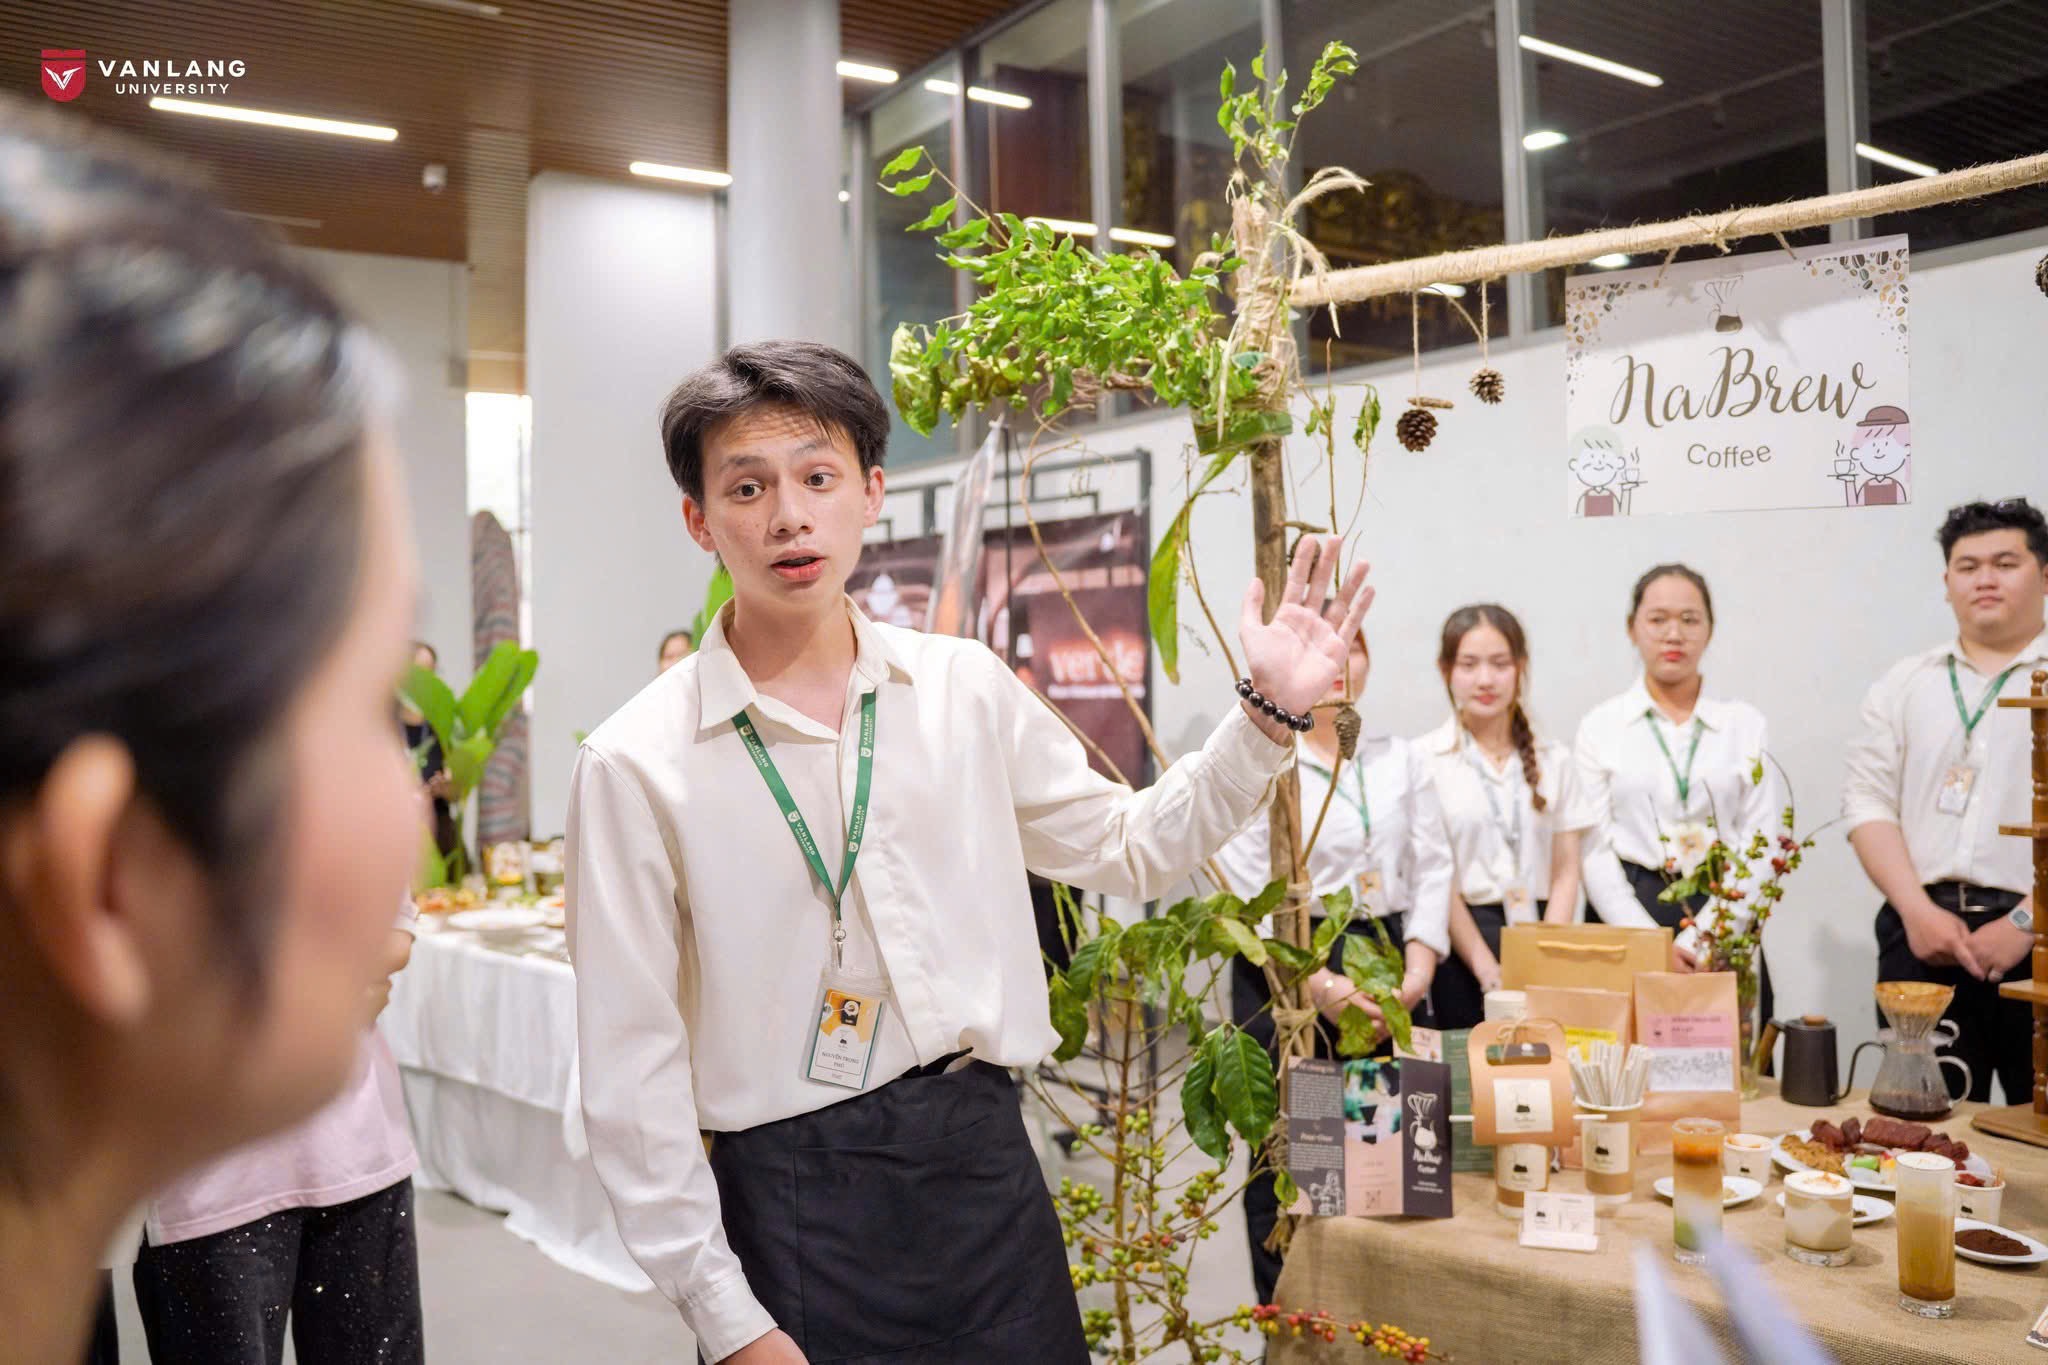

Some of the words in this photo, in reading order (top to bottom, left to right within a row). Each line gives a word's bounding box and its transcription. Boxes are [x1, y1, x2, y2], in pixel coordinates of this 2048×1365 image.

[1687, 443, 1772, 469] Coffee
[797, 822, 816, 856] VANLANG
[851, 804, 863, 840] VANLANG
